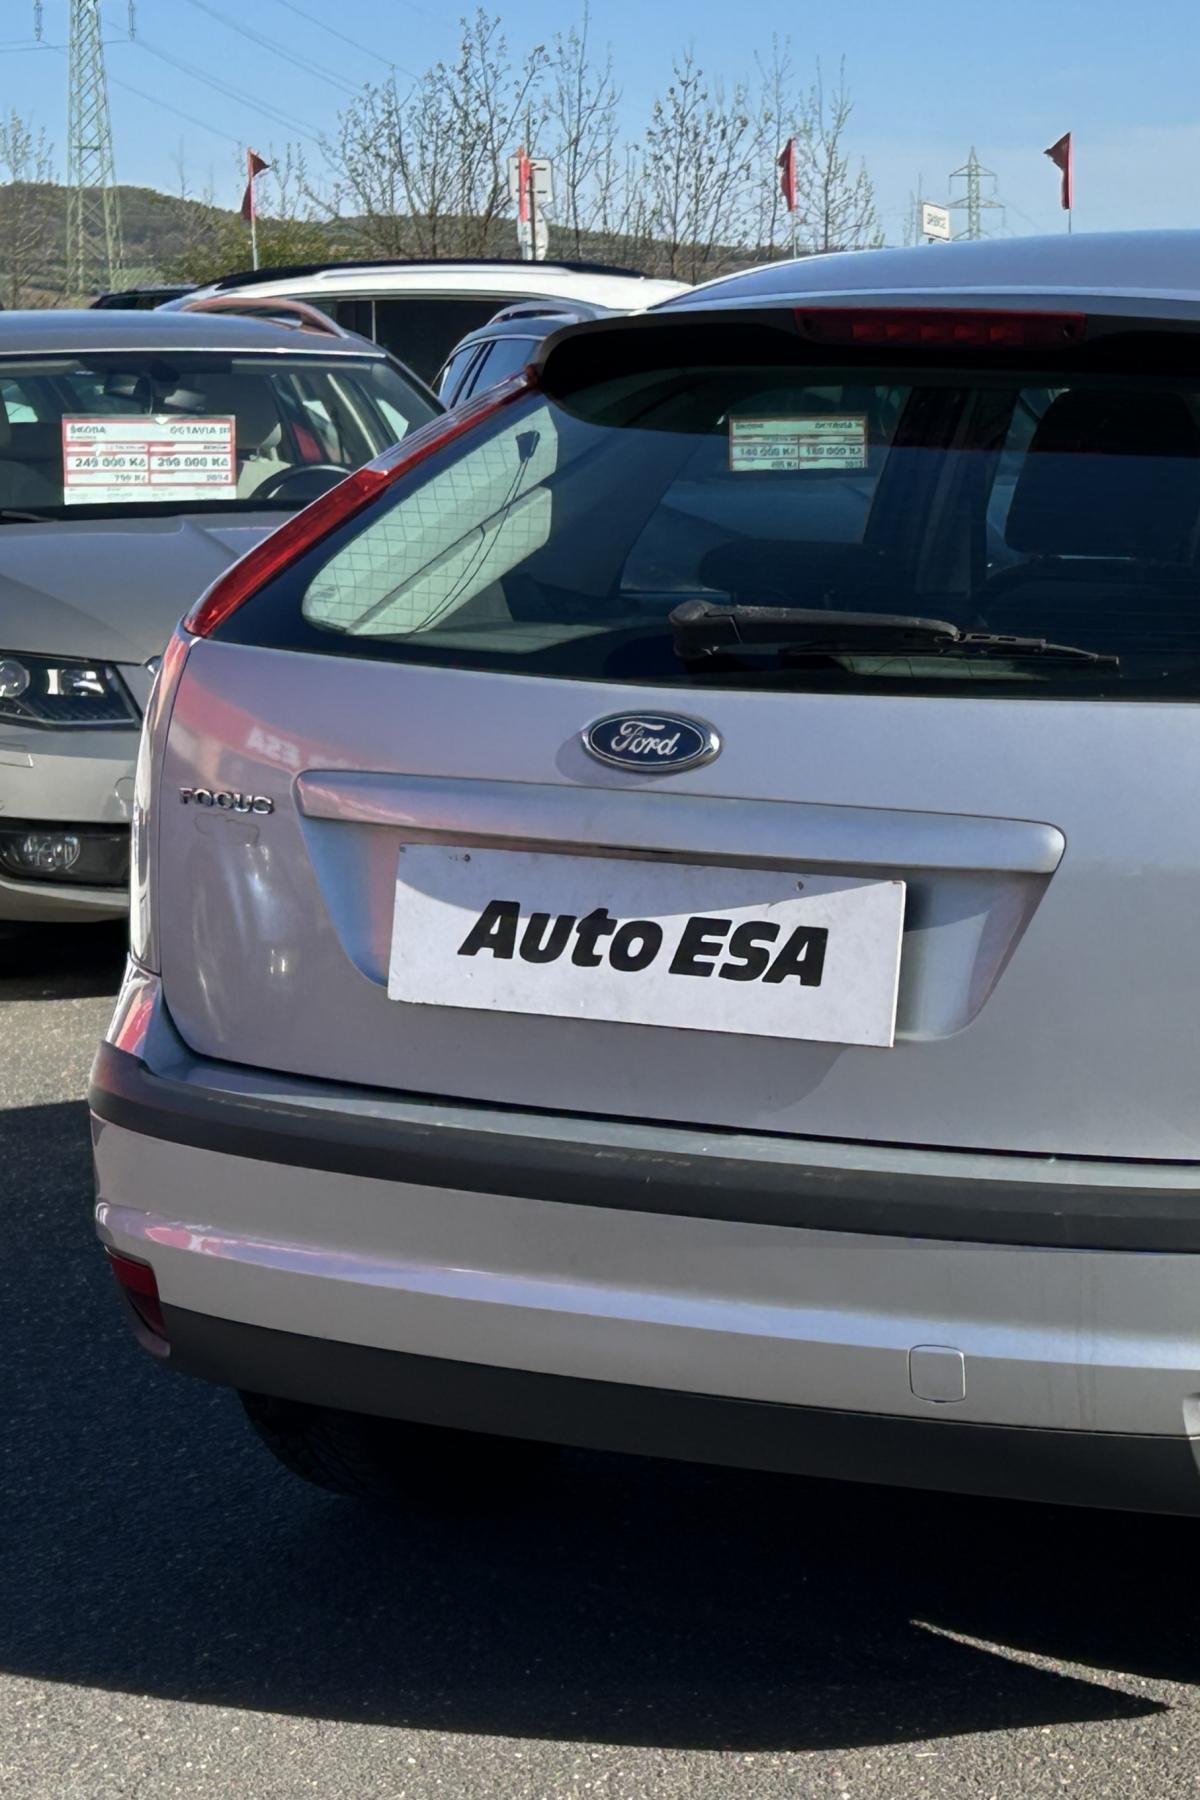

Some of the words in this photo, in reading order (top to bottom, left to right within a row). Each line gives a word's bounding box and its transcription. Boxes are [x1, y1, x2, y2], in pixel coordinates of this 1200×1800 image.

[169, 427, 216, 435] OCTAVIA
[102, 457, 126, 468] 000
[611, 721, 681, 756] Ford
[179, 787, 274, 815] FOCUS
[458, 899, 663, 973] Auto
[668, 916, 829, 988] ESA
